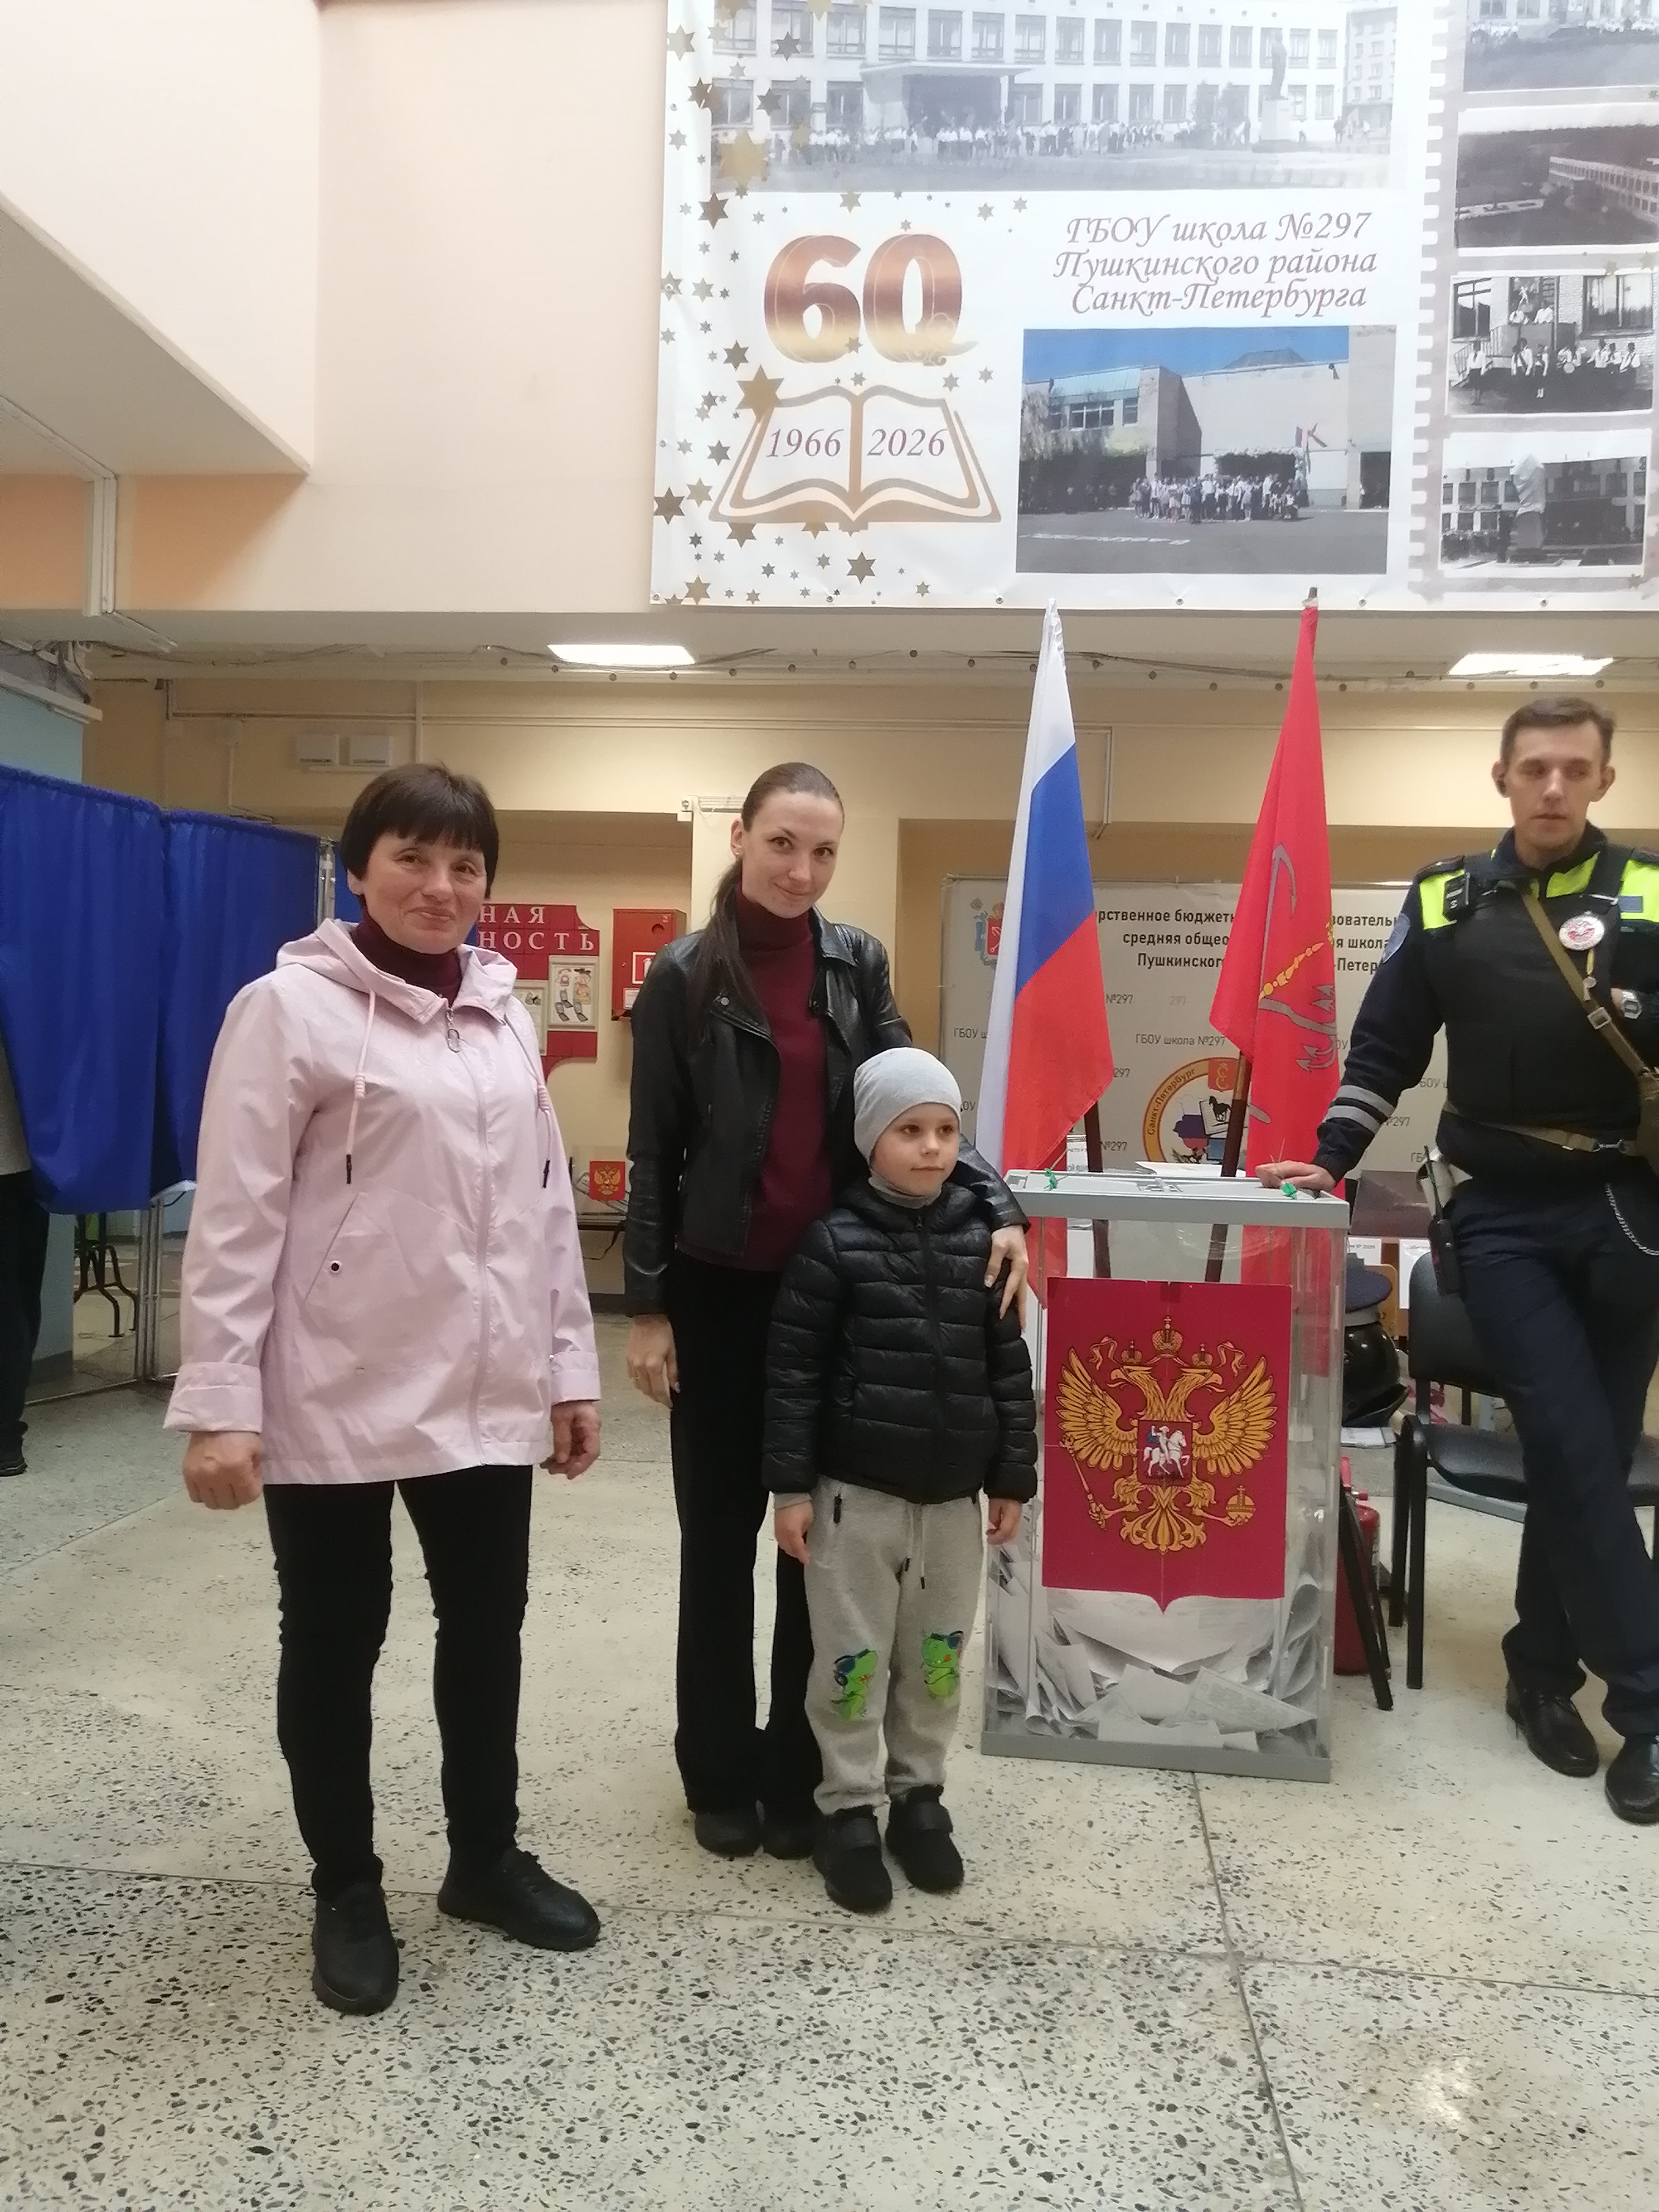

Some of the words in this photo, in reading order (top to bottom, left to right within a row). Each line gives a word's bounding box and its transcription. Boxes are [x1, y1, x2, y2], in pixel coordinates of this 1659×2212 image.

[1067, 214, 1170, 247] ГБОУ
[1173, 220, 1268, 248] школа
[1275, 212, 1372, 241] №297
[1052, 249, 1259, 286] Пушкинского
[1268, 249, 1377, 283] района
[764, 233, 963, 366] 60
[1072, 278, 1367, 318] Санкт-Петербурга
[766, 428, 844, 457] 1966
[867, 428, 947, 457] 2026
[1096, 910, 1171, 924] рственное
[478, 931, 595, 950] НОСТЬ
[1123, 932, 1181, 947] средняя
[954, 1028, 978, 1039] ГБОУ
[1136, 1034, 1161, 1045] ГБОУ
[1164, 1036, 1195, 1045] школа
[1198, 1035, 1226, 1046] №297
